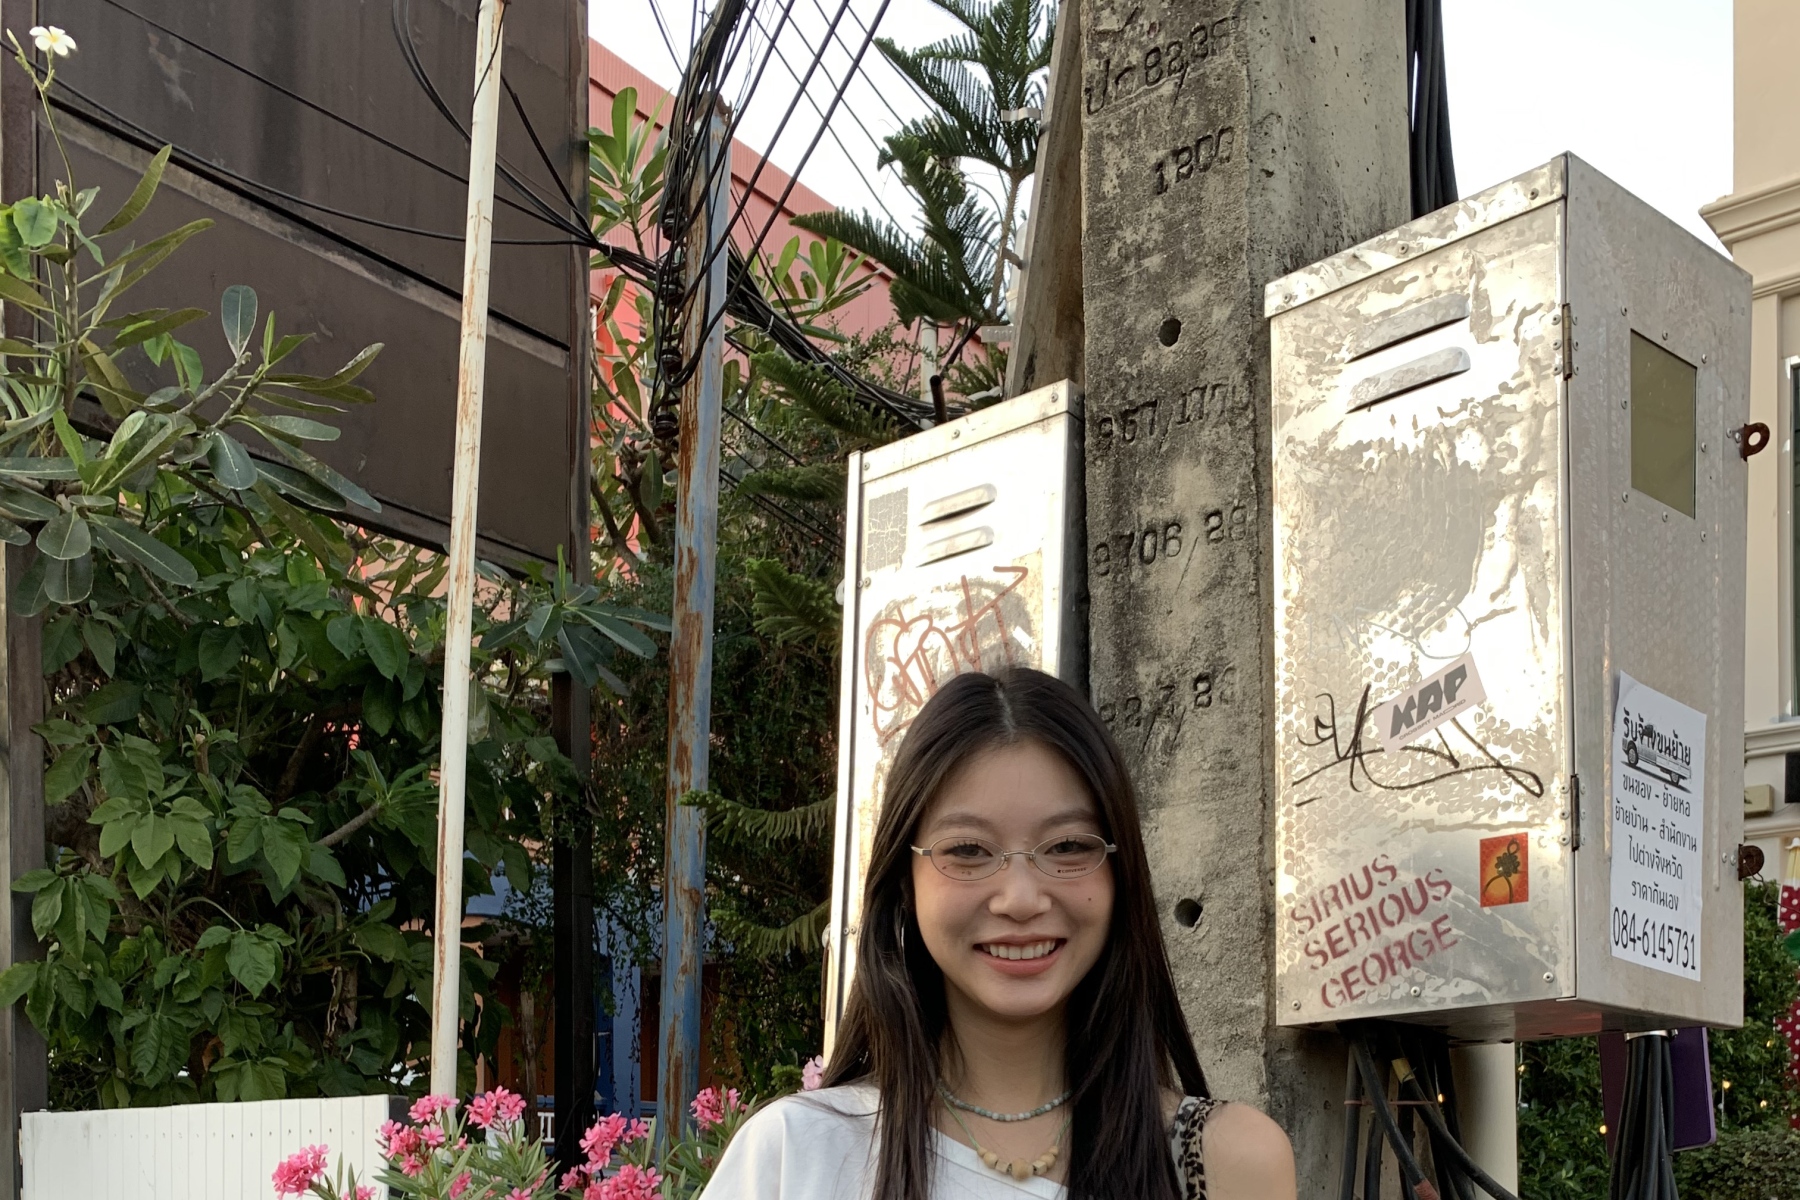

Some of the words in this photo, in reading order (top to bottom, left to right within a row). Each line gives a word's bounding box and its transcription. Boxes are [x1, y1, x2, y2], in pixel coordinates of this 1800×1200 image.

[1389, 663, 1468, 740] KAP
[1398, 717, 1432, 741] CROSSFIT
[1432, 698, 1467, 722] MADRID
[1615, 797, 1649, 833] ย้ายบ้าน
[1659, 818, 1697, 852] สำนักงาน
[1622, 773, 1652, 800] ขนของ
[1662, 784, 1691, 817] ย้ายหอ
[1628, 834, 1683, 880] ไปต่างจังหวัด
[1291, 853, 1398, 935] SIRIUS
[1304, 868, 1453, 970] SERIOUS
[1631, 880, 1679, 912] ราคากันเอง
[1321, 914, 1459, 1008] GEORGE
[1612, 906, 1696, 971] 084-6145731
